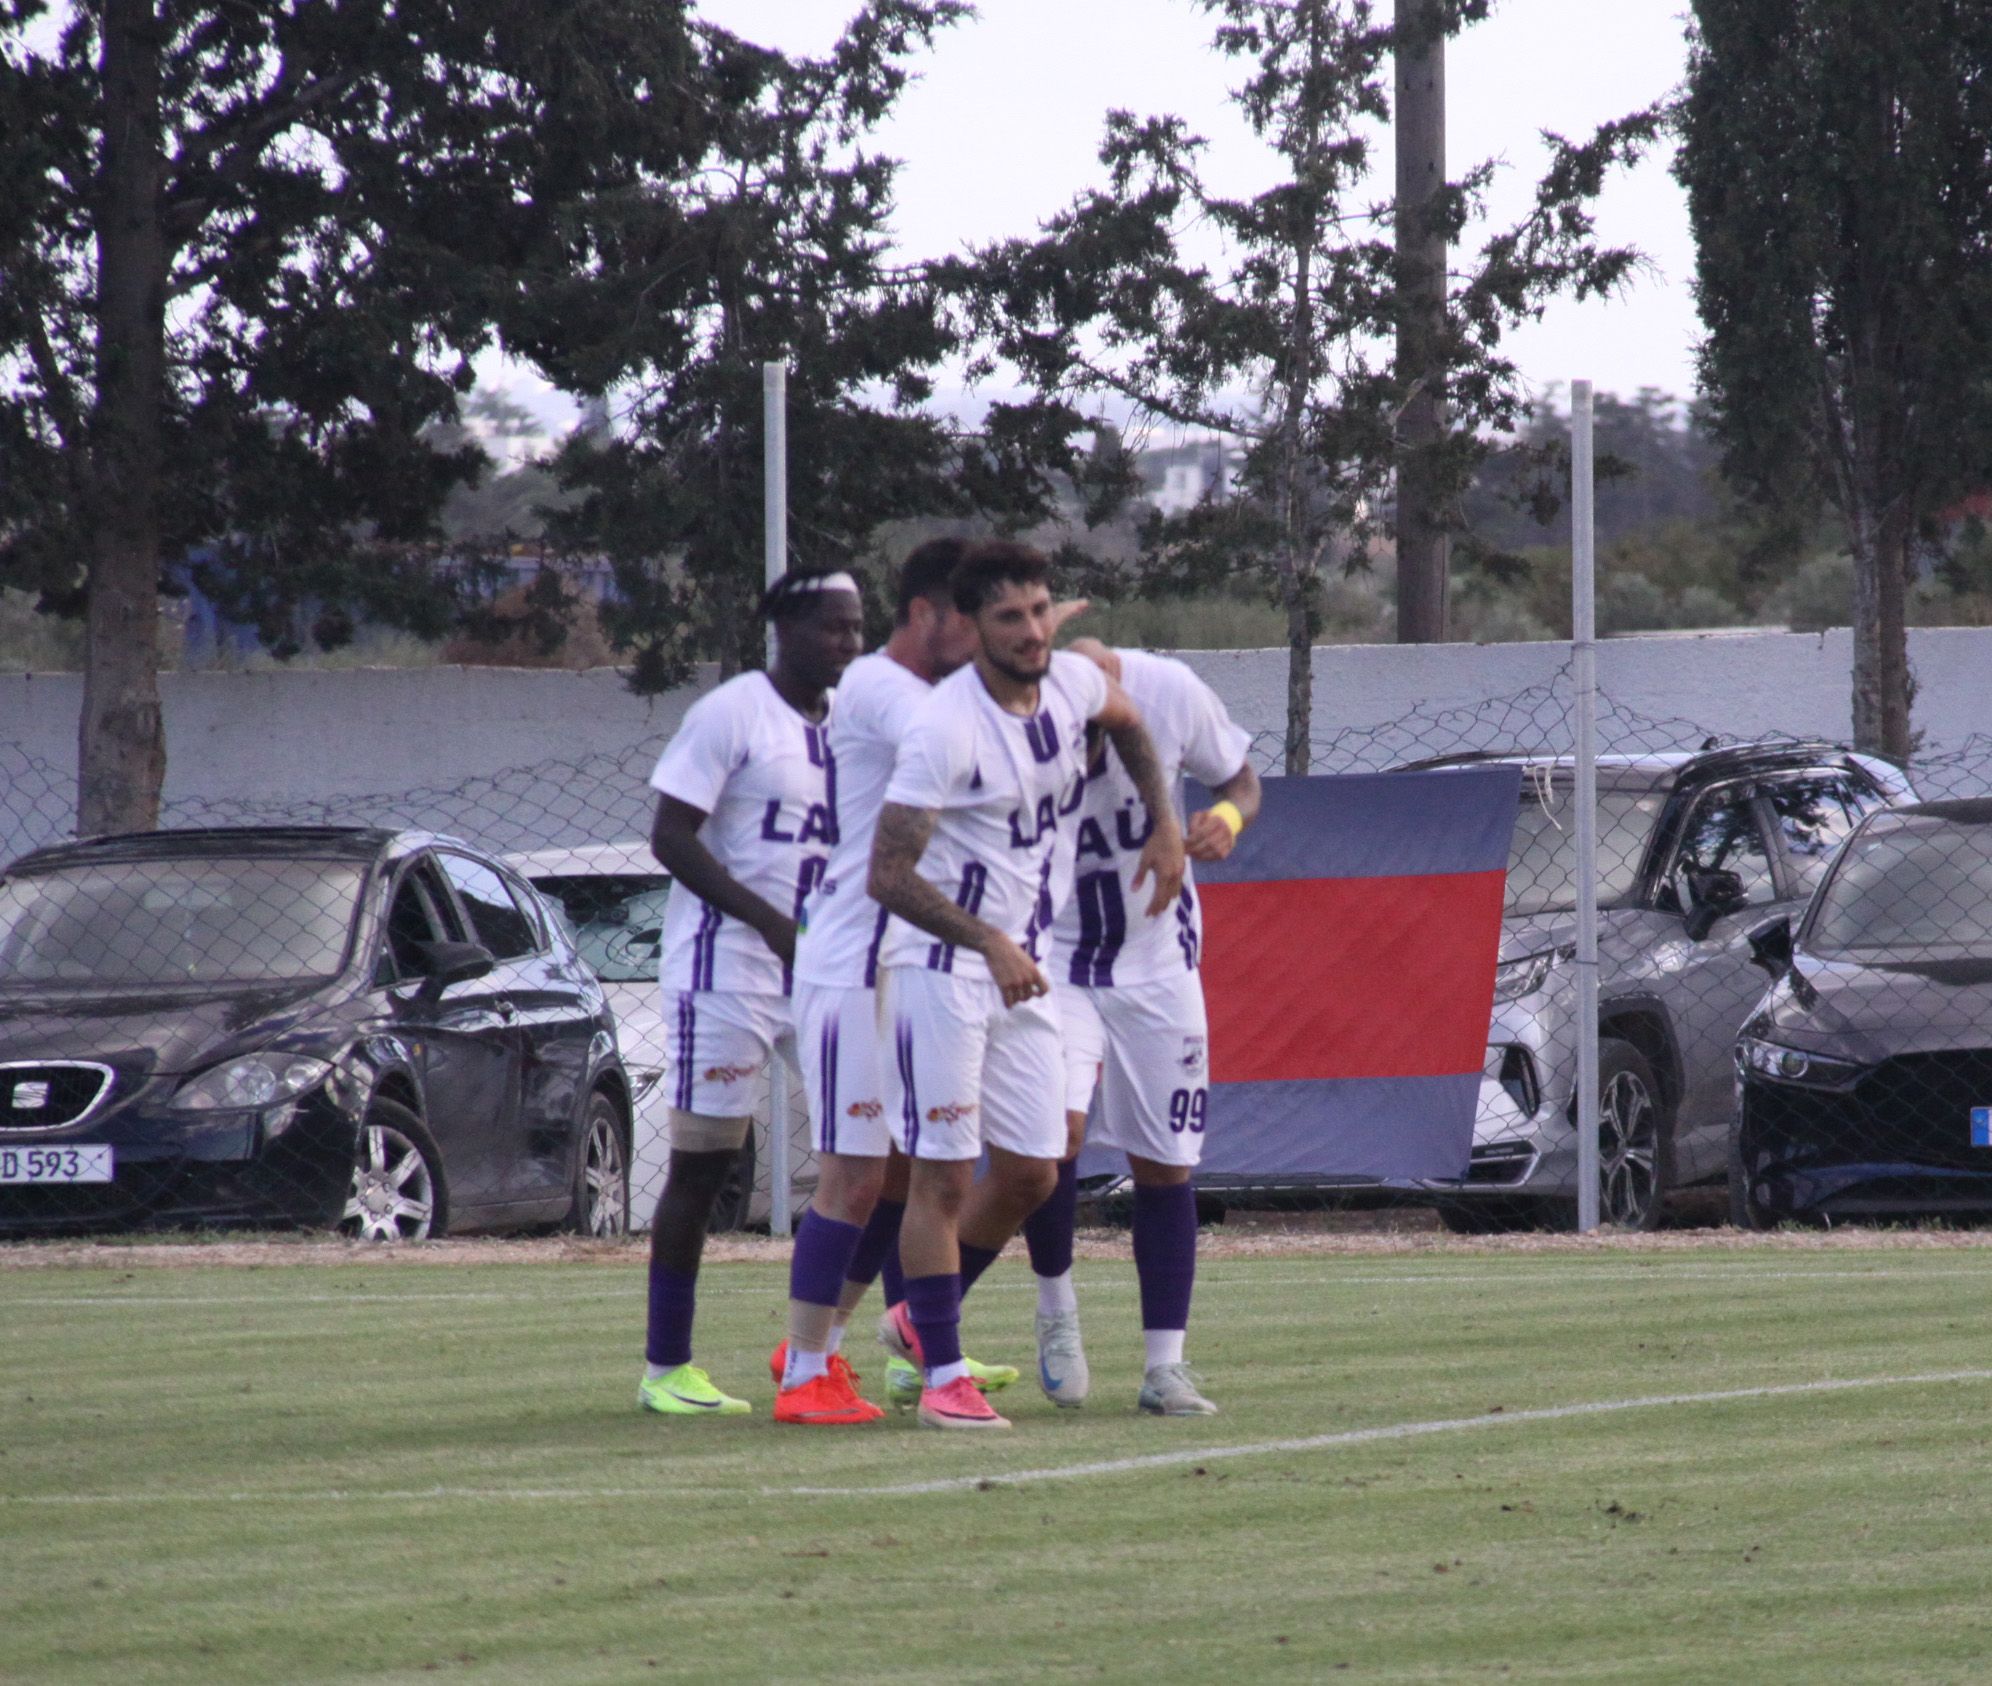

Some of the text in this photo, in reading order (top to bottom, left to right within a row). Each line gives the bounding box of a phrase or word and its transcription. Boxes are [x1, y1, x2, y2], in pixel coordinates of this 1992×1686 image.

[761, 798, 837, 845] LA
[1169, 1087, 1207, 1133] 99
[27, 1150, 79, 1178] 593
